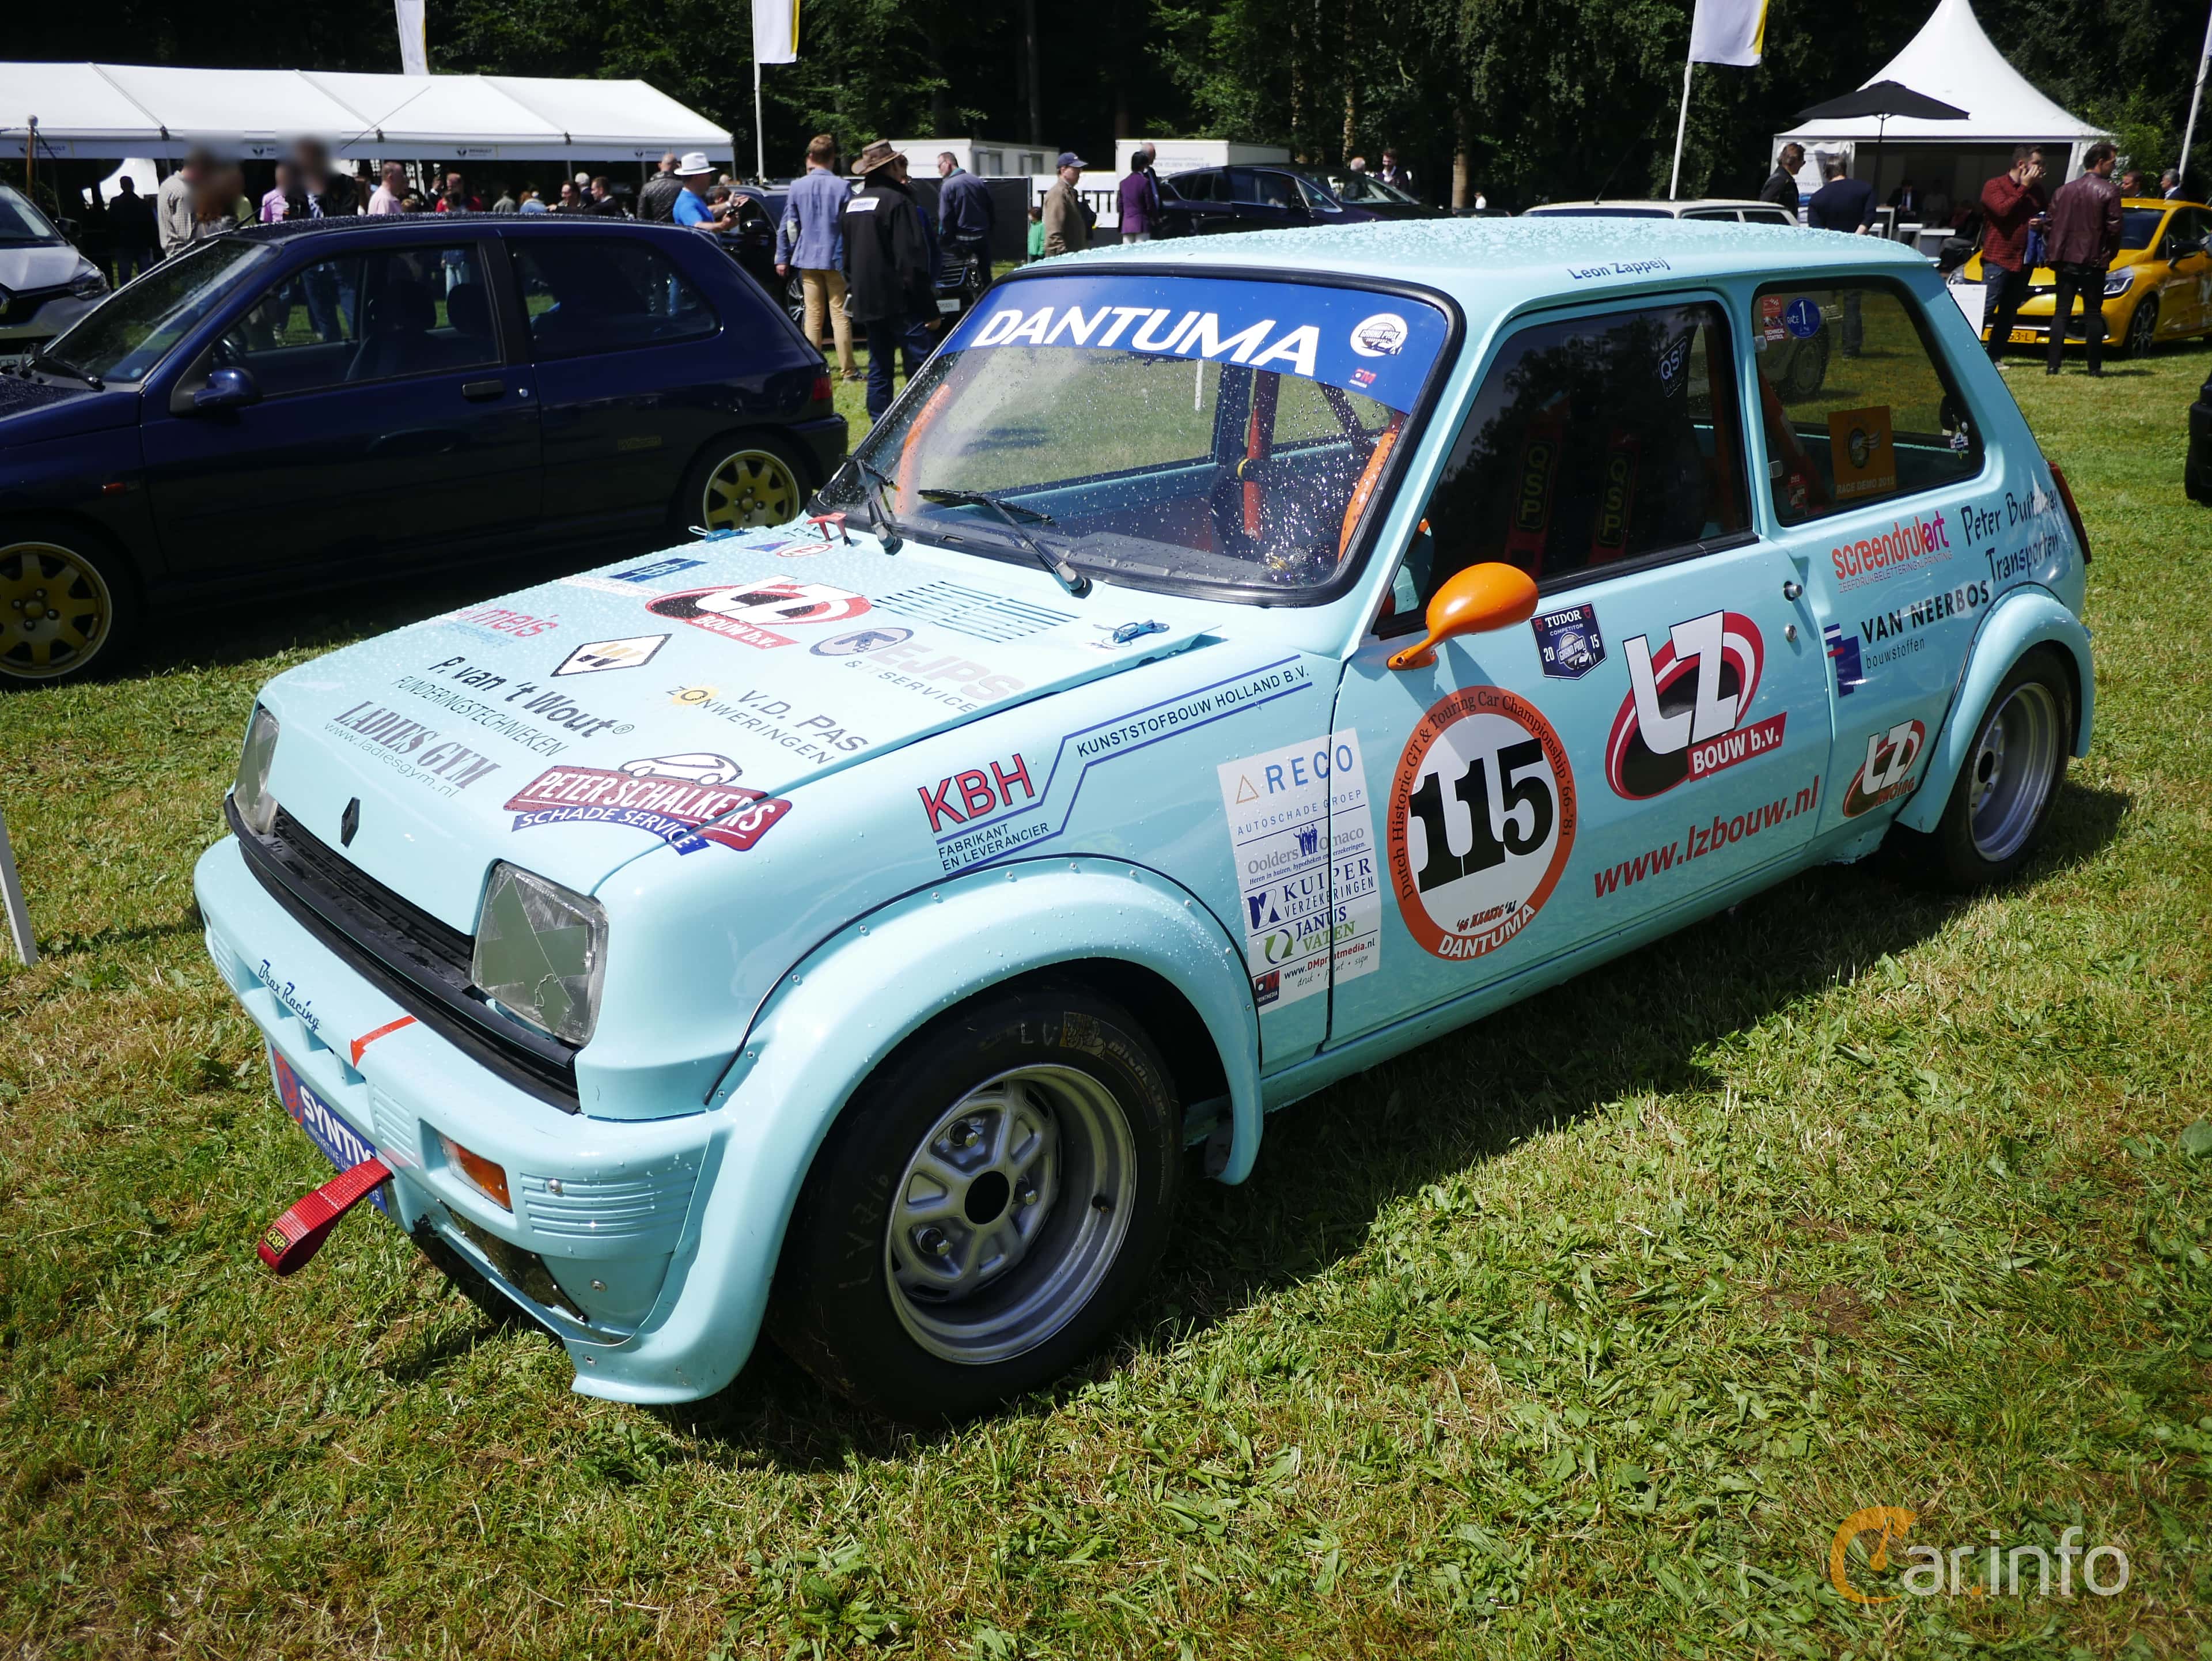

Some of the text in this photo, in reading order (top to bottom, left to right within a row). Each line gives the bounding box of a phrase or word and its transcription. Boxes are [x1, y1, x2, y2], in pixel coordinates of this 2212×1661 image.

[1567, 257, 1671, 279] Leon Zappeij
[971, 306, 1320, 377] DANTUMA
[1661, 341, 1687, 379] QSP
[1831, 510, 1950, 580] screendrukart
[1960, 505, 2001, 547] Peter
[1985, 534, 2059, 584] Transporten
[692, 615, 750, 635] BOUW
[1545, 610, 1582, 628] TUDOR
[1550, 623, 1584, 636] COMPETITOR
[1861, 580, 1989, 644] VAN NEERBOS
[1543, 646, 1555, 662] 20
[1559, 645, 1574, 661] GRAND
[1590, 634, 1600, 649] 15
[1866, 637, 1925, 669] bouwstoffen
[427, 656, 465, 674] P.
[452, 667, 507, 691] van
[866, 641, 1026, 701] EJPS
[1623, 609, 1739, 755] LZ
[391, 675, 571, 757] FUNDERINGSTECHNIEKEN
[1077, 665, 1309, 758] KUNSTSTOFBOUW HOLLAND B.V.
[1428, 695, 1476, 730] Touring
[1478, 691, 1499, 707] Car
[333, 700, 502, 789] LADIES GYM
[666, 686, 838, 765] ZONWERINGEN
[795, 714, 871, 752] PAS
[1420, 728, 1433, 743] &
[1502, 695, 1567, 780] Championship
[324, 722, 461, 799] www.ladiesgym.nl
[1265, 744, 1353, 794] RECO
[1406, 742, 1426, 767] GT
[1692, 727, 1780, 775] BOUW b.v.
[1862, 718, 1914, 795] LZ
[525, 771, 775, 831] PETER SCHALKERS
[917, 752, 1036, 834] KBH
[1238, 789, 1362, 836] AUTOSCHADE GROEP
[1392, 770, 1412, 843] Historic
[520, 808, 698, 848] SCHADE SERVICE
[1408, 737, 1554, 894] 115
[1593, 774, 1820, 899] www.lzbouw.nl
[938, 823, 1009, 858] FABRIKANT
[942, 822, 1050, 871] EN LEVERANCIER
[1248, 847, 1298, 875] Oolders
[1249, 875, 1266, 885] Heren
[1273, 866, 1293, 877] huizen,
[1293, 856, 1322, 871] hypotheken
[1333, 842, 1366, 856] erzekeringen.
[1282, 857, 1372, 902] KUIPER
[1393, 846, 1414, 901] Dutch
[1285, 876, 1374, 918] VERZEKERINGEN
[1296, 906, 1347, 941] JANUS
[1302, 921, 1356, 952] VATEN
[1438, 903, 1536, 958] DANTUMA
[1297, 971, 1314, 987] druk
[1355, 955, 1368, 968] sign
[258, 959, 320, 1032] Brax Racing
[307, 1121, 341, 1164] INNOVATIVE
[267, 1231, 286, 1247] QSP
